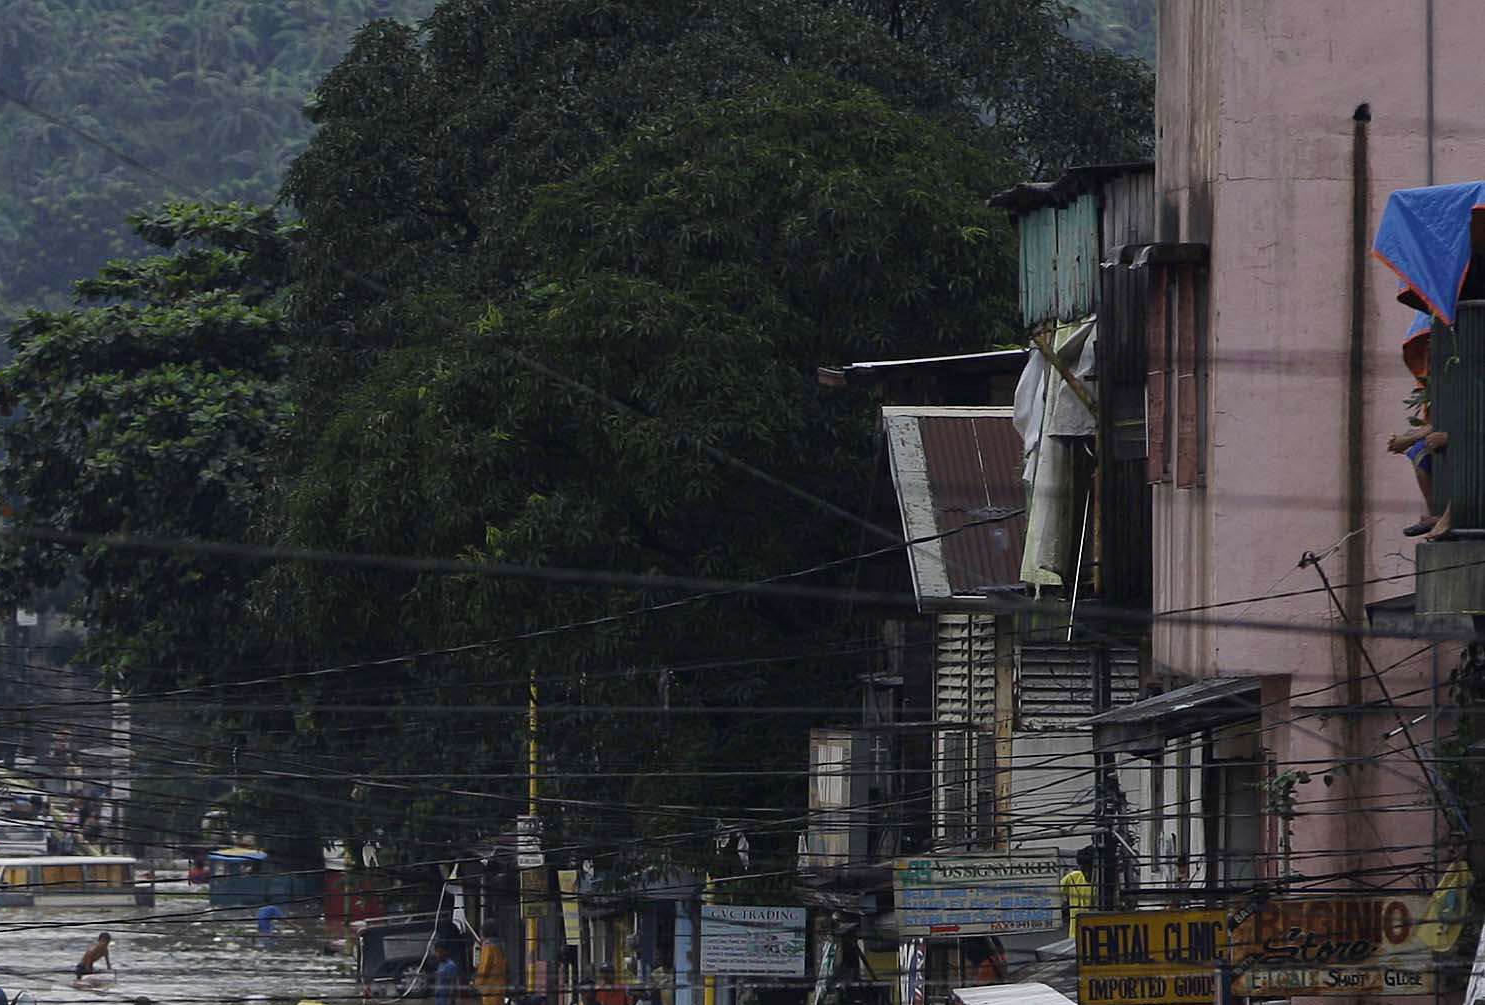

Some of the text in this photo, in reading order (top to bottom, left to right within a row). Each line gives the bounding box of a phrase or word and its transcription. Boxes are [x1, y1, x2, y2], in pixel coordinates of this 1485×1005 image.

[742, 909, 799, 921] TRADING
[1081, 921, 1223, 965] DENTAL CLINIC
[1089, 976, 1167, 1000] IMPORTED
